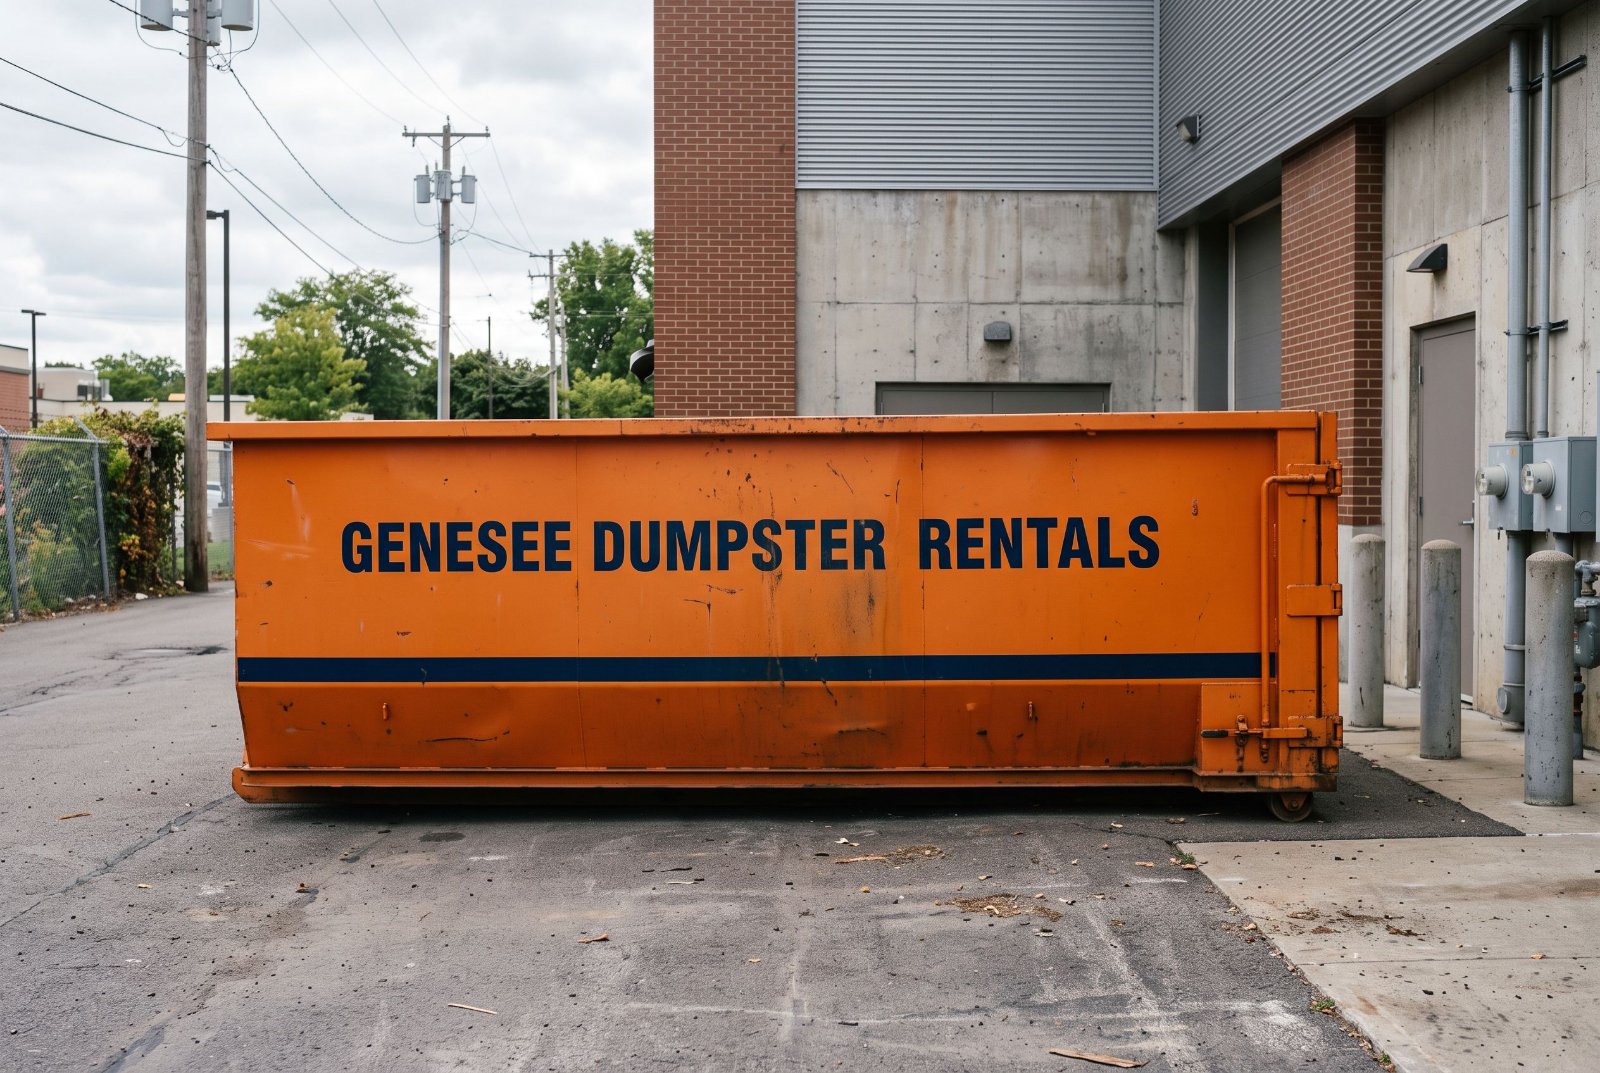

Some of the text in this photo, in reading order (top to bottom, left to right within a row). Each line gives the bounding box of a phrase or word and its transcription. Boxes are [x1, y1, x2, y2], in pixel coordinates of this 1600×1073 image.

[342, 515, 1160, 573] GENESEE DUMPSTER RENTALS
